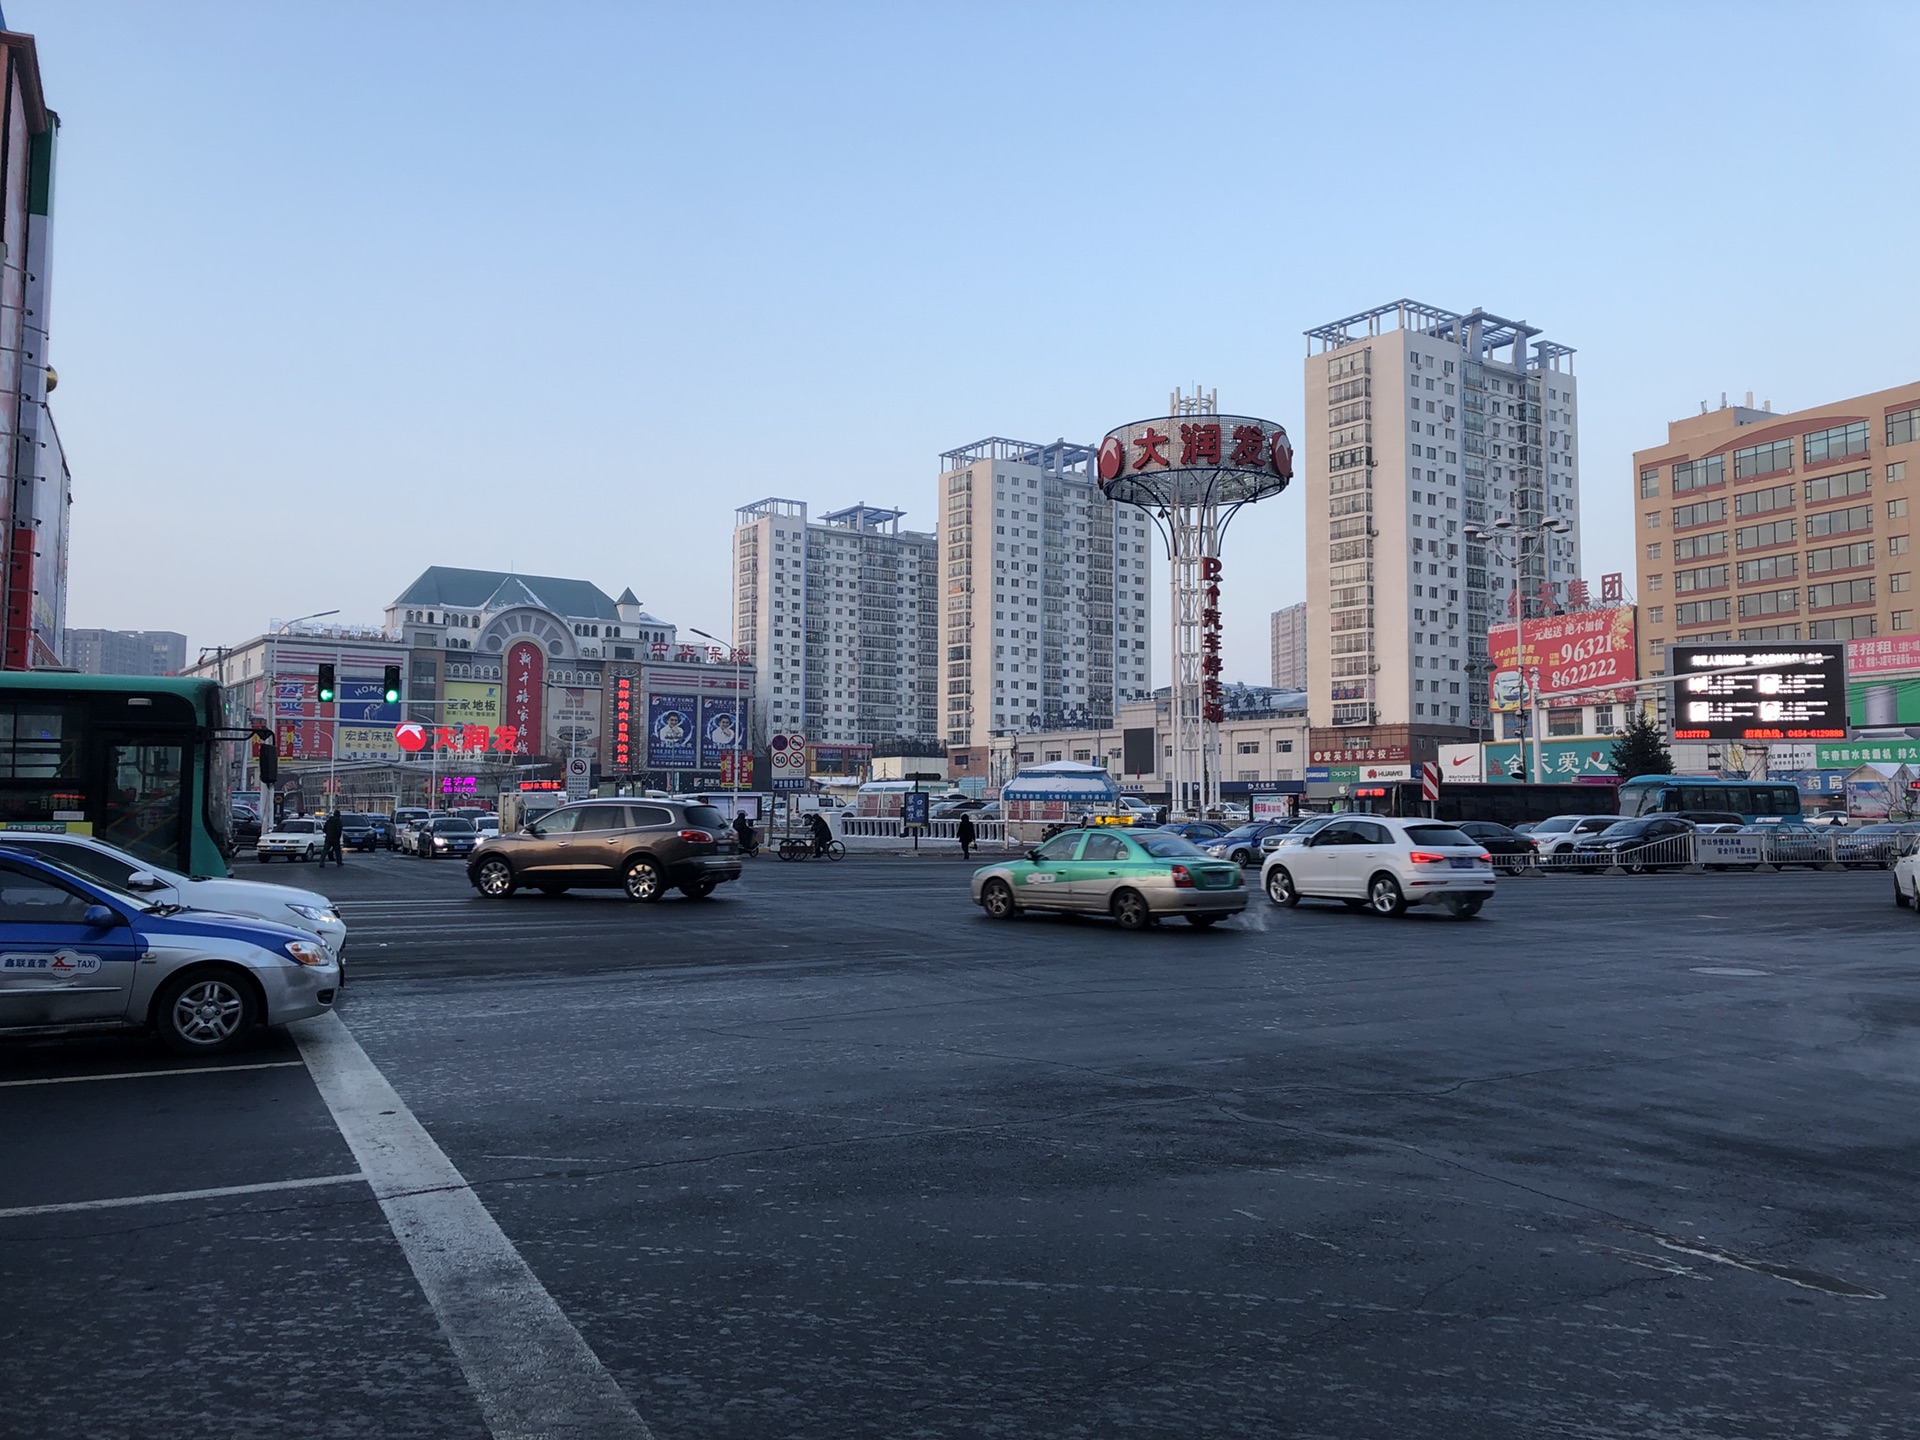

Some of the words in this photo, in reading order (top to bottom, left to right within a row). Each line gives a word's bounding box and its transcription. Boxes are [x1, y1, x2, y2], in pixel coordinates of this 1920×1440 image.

[1133, 423, 1266, 471] 大润发
[1202, 557, 1222, 580] P
[1507, 572, 1623, 619] 金天集团
[1525, 625, 1562, 642] 一元起送
[1565, 619, 1605, 636] 绝不加价
[651, 642, 749, 664] 中华保险
[1561, 633, 1613, 664] 96321
[1202, 608, 1224, 723] 汽车停车场
[1551, 658, 1617, 688] 8622222
[447, 698, 496, 712] 圣象地板
[431, 724, 519, 752] 大润发
[775, 756, 785, 764] 50
[1323, 749, 1387, 761] 爱英培训学校
[1504, 751, 1610, 776] 金天爱心
[1378, 769, 1403, 777] HUAWEI
[4, 958, 48, 968] 鑫联直营
[77, 959, 96, 968] TAXI
